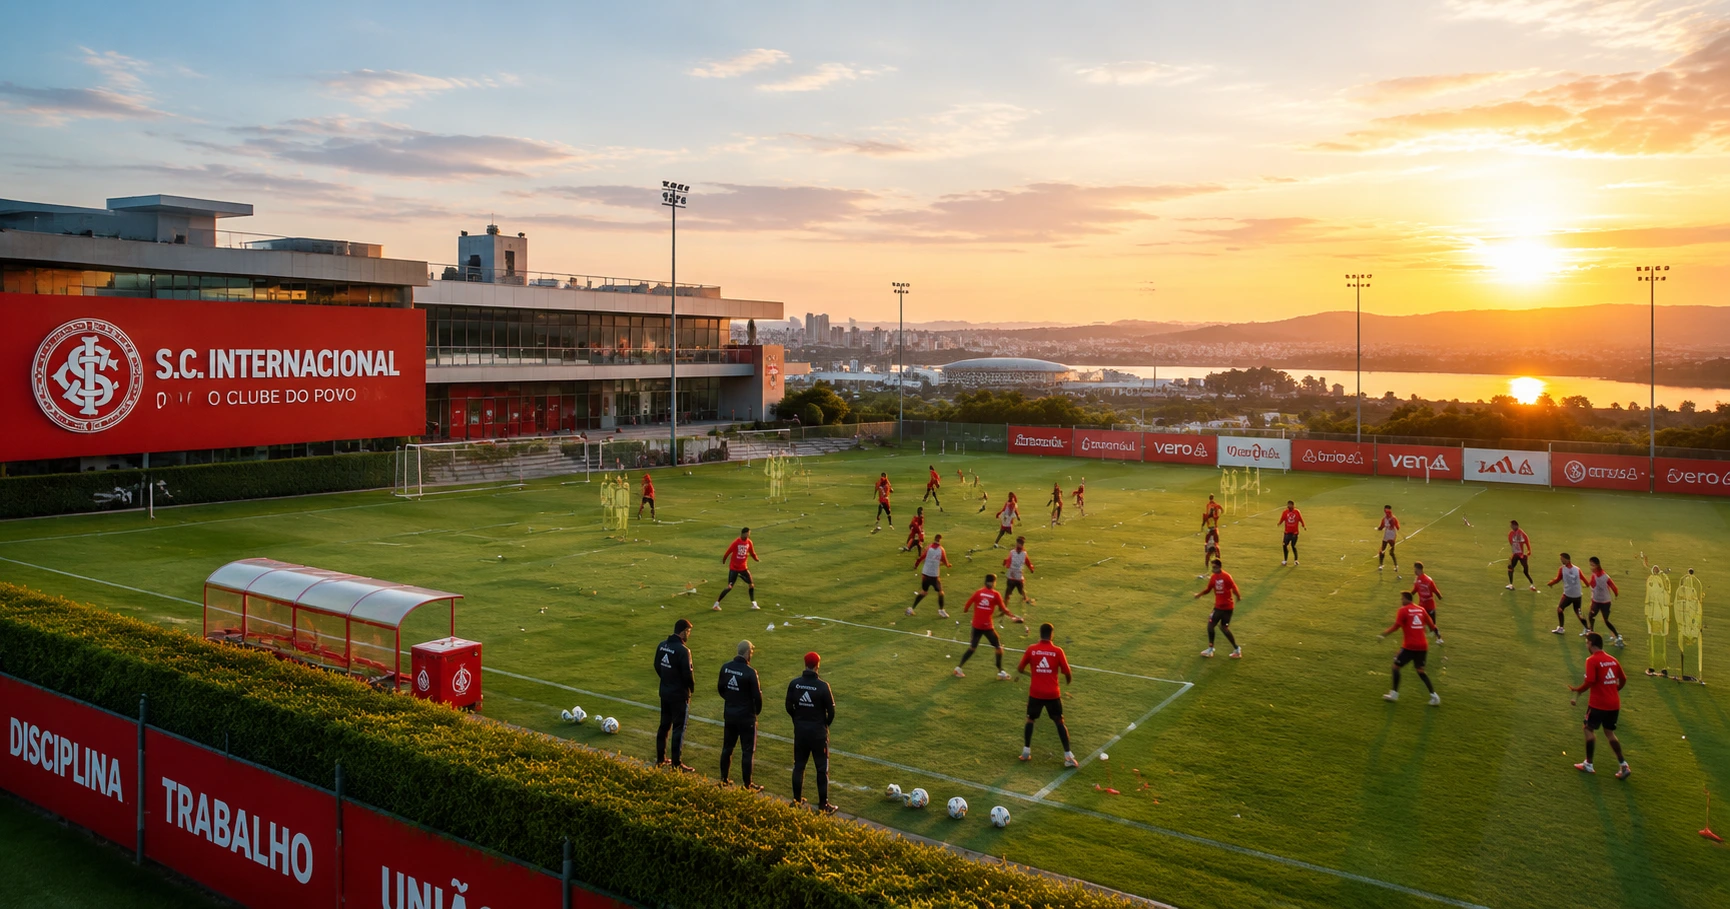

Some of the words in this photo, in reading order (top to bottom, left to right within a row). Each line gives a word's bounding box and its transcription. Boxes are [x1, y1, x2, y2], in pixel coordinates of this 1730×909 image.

[155, 348, 204, 379] S.C.
[209, 349, 400, 378] INTERNACIONAL
[208, 390, 220, 405] O
[226, 389, 280, 405] CLUBE
[285, 389, 309, 403] DO
[314, 387, 357, 402] POVO
[10, 717, 123, 802] DISCIPLINA
[161, 777, 313, 884] TRABALHO
[381, 865, 491, 909] UNIÃ
